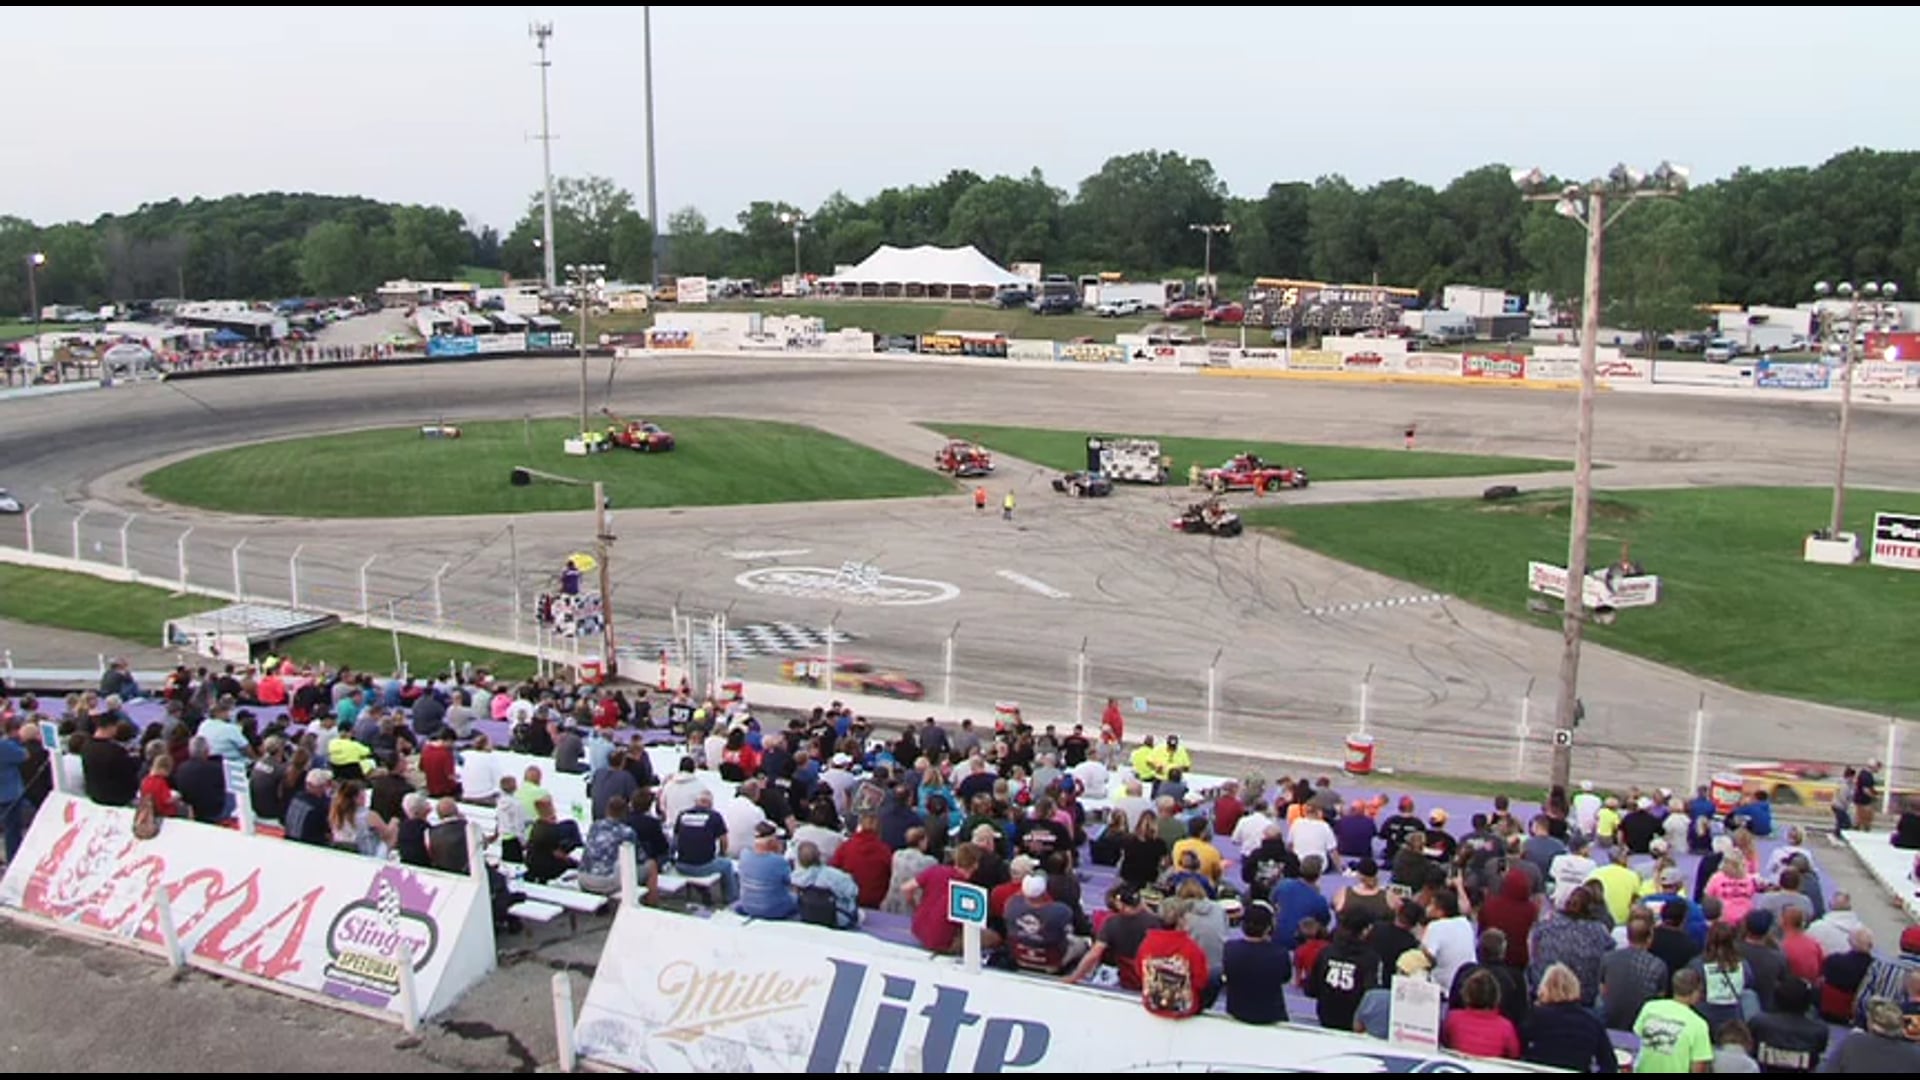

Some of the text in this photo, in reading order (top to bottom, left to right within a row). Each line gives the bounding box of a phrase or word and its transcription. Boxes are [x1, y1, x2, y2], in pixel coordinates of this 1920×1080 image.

[951, 884, 986, 923] D
[1325, 966, 1356, 991] 45
[657, 956, 1052, 1074] Miller lite
